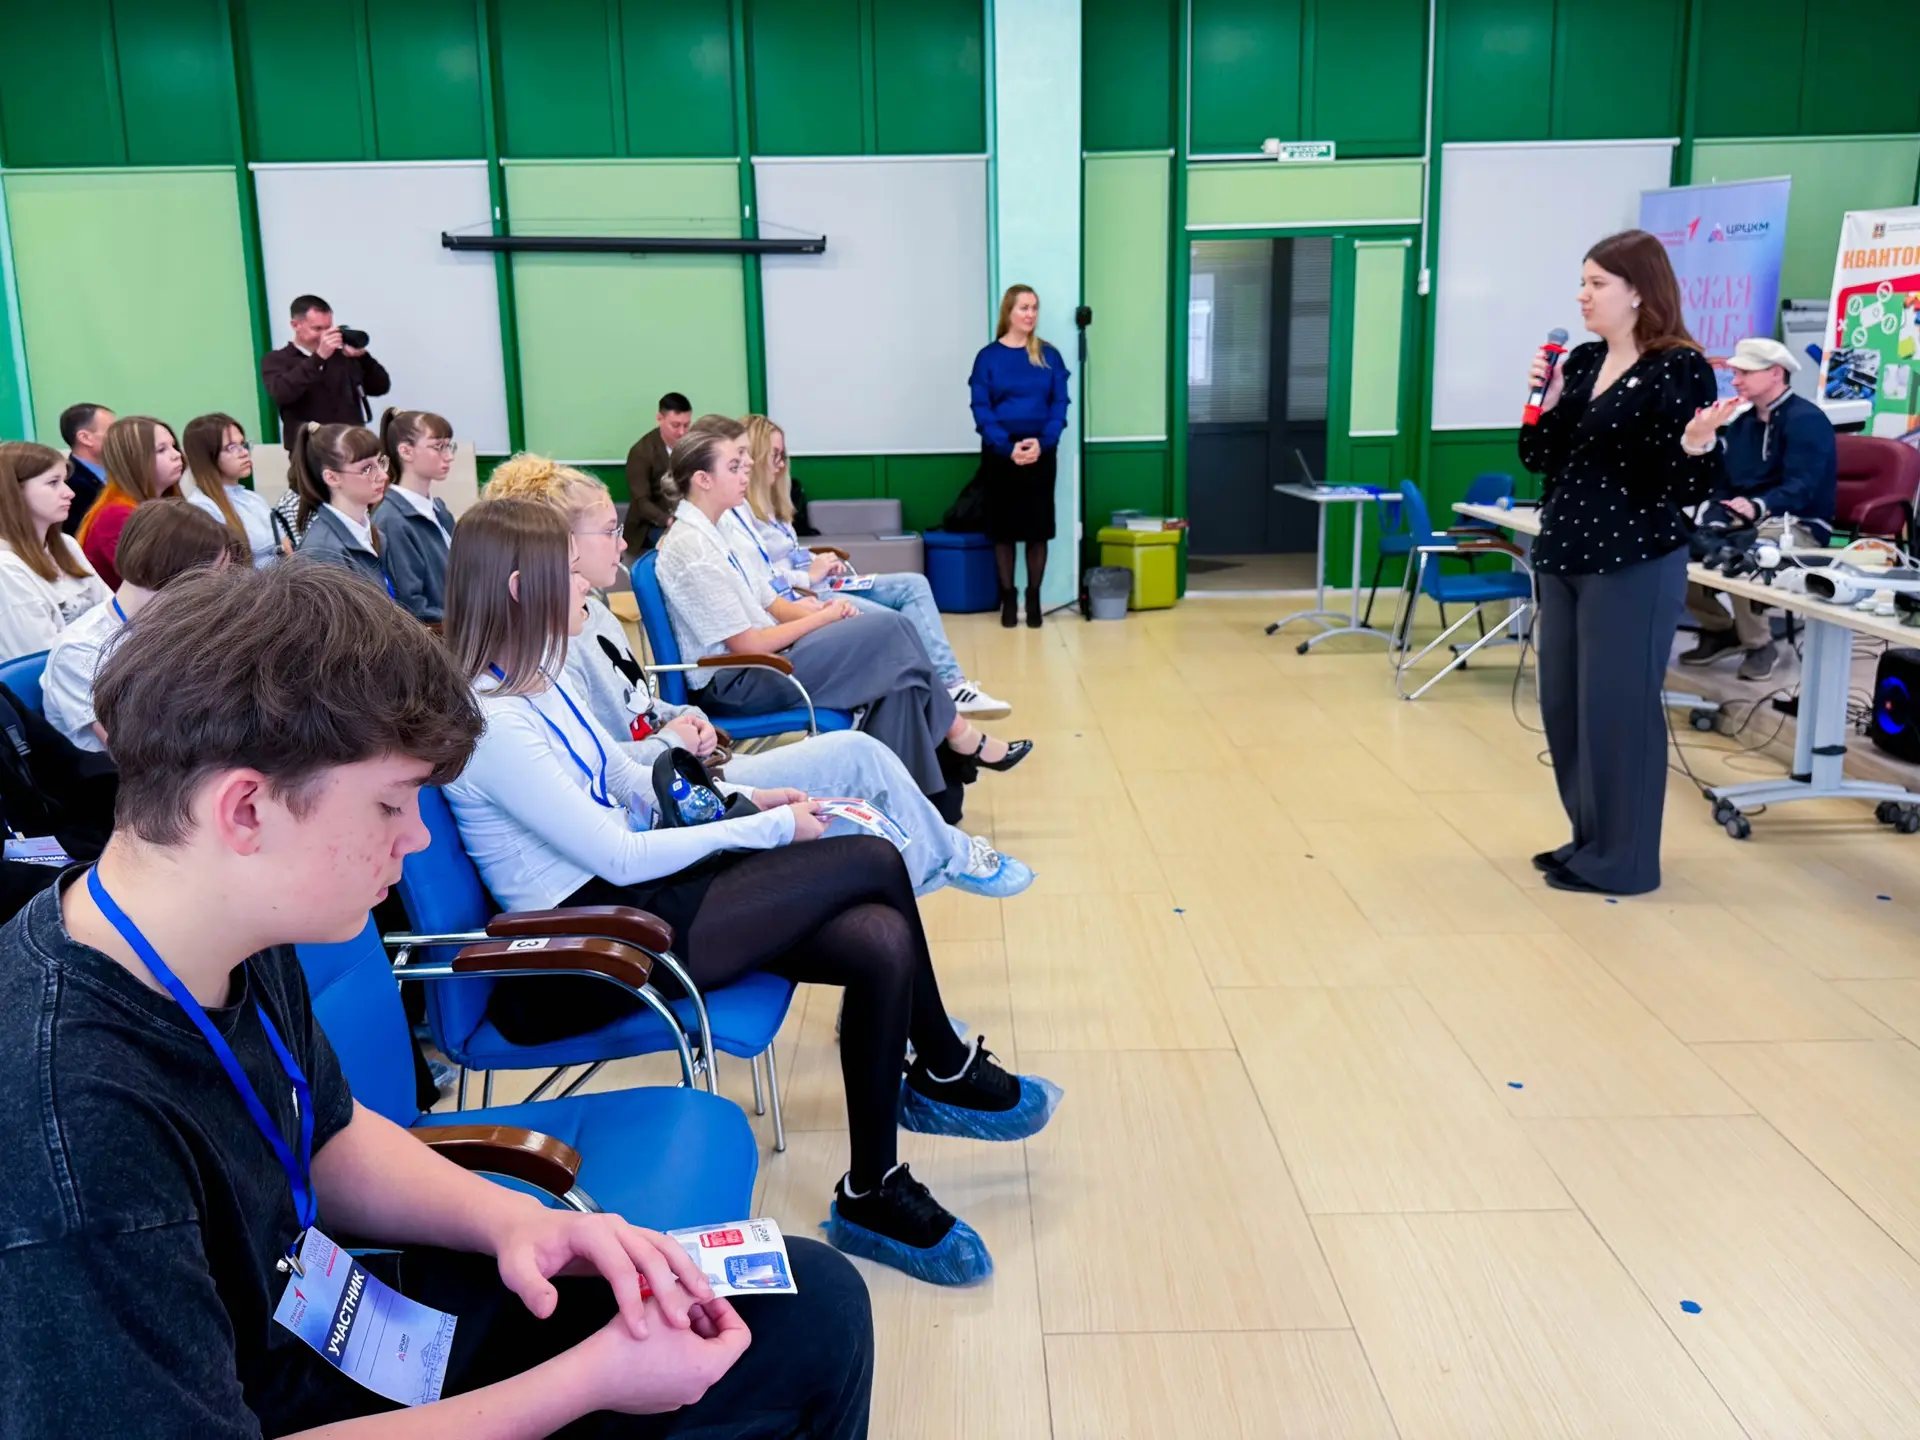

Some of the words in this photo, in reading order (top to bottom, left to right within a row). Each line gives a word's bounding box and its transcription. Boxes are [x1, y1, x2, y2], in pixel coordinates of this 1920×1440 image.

[1725, 221, 1770, 235] ЦРЦКМ
[1681, 274, 1752, 309] СКАЯ
[328, 1269, 365, 1357] УЧАСТНИК
